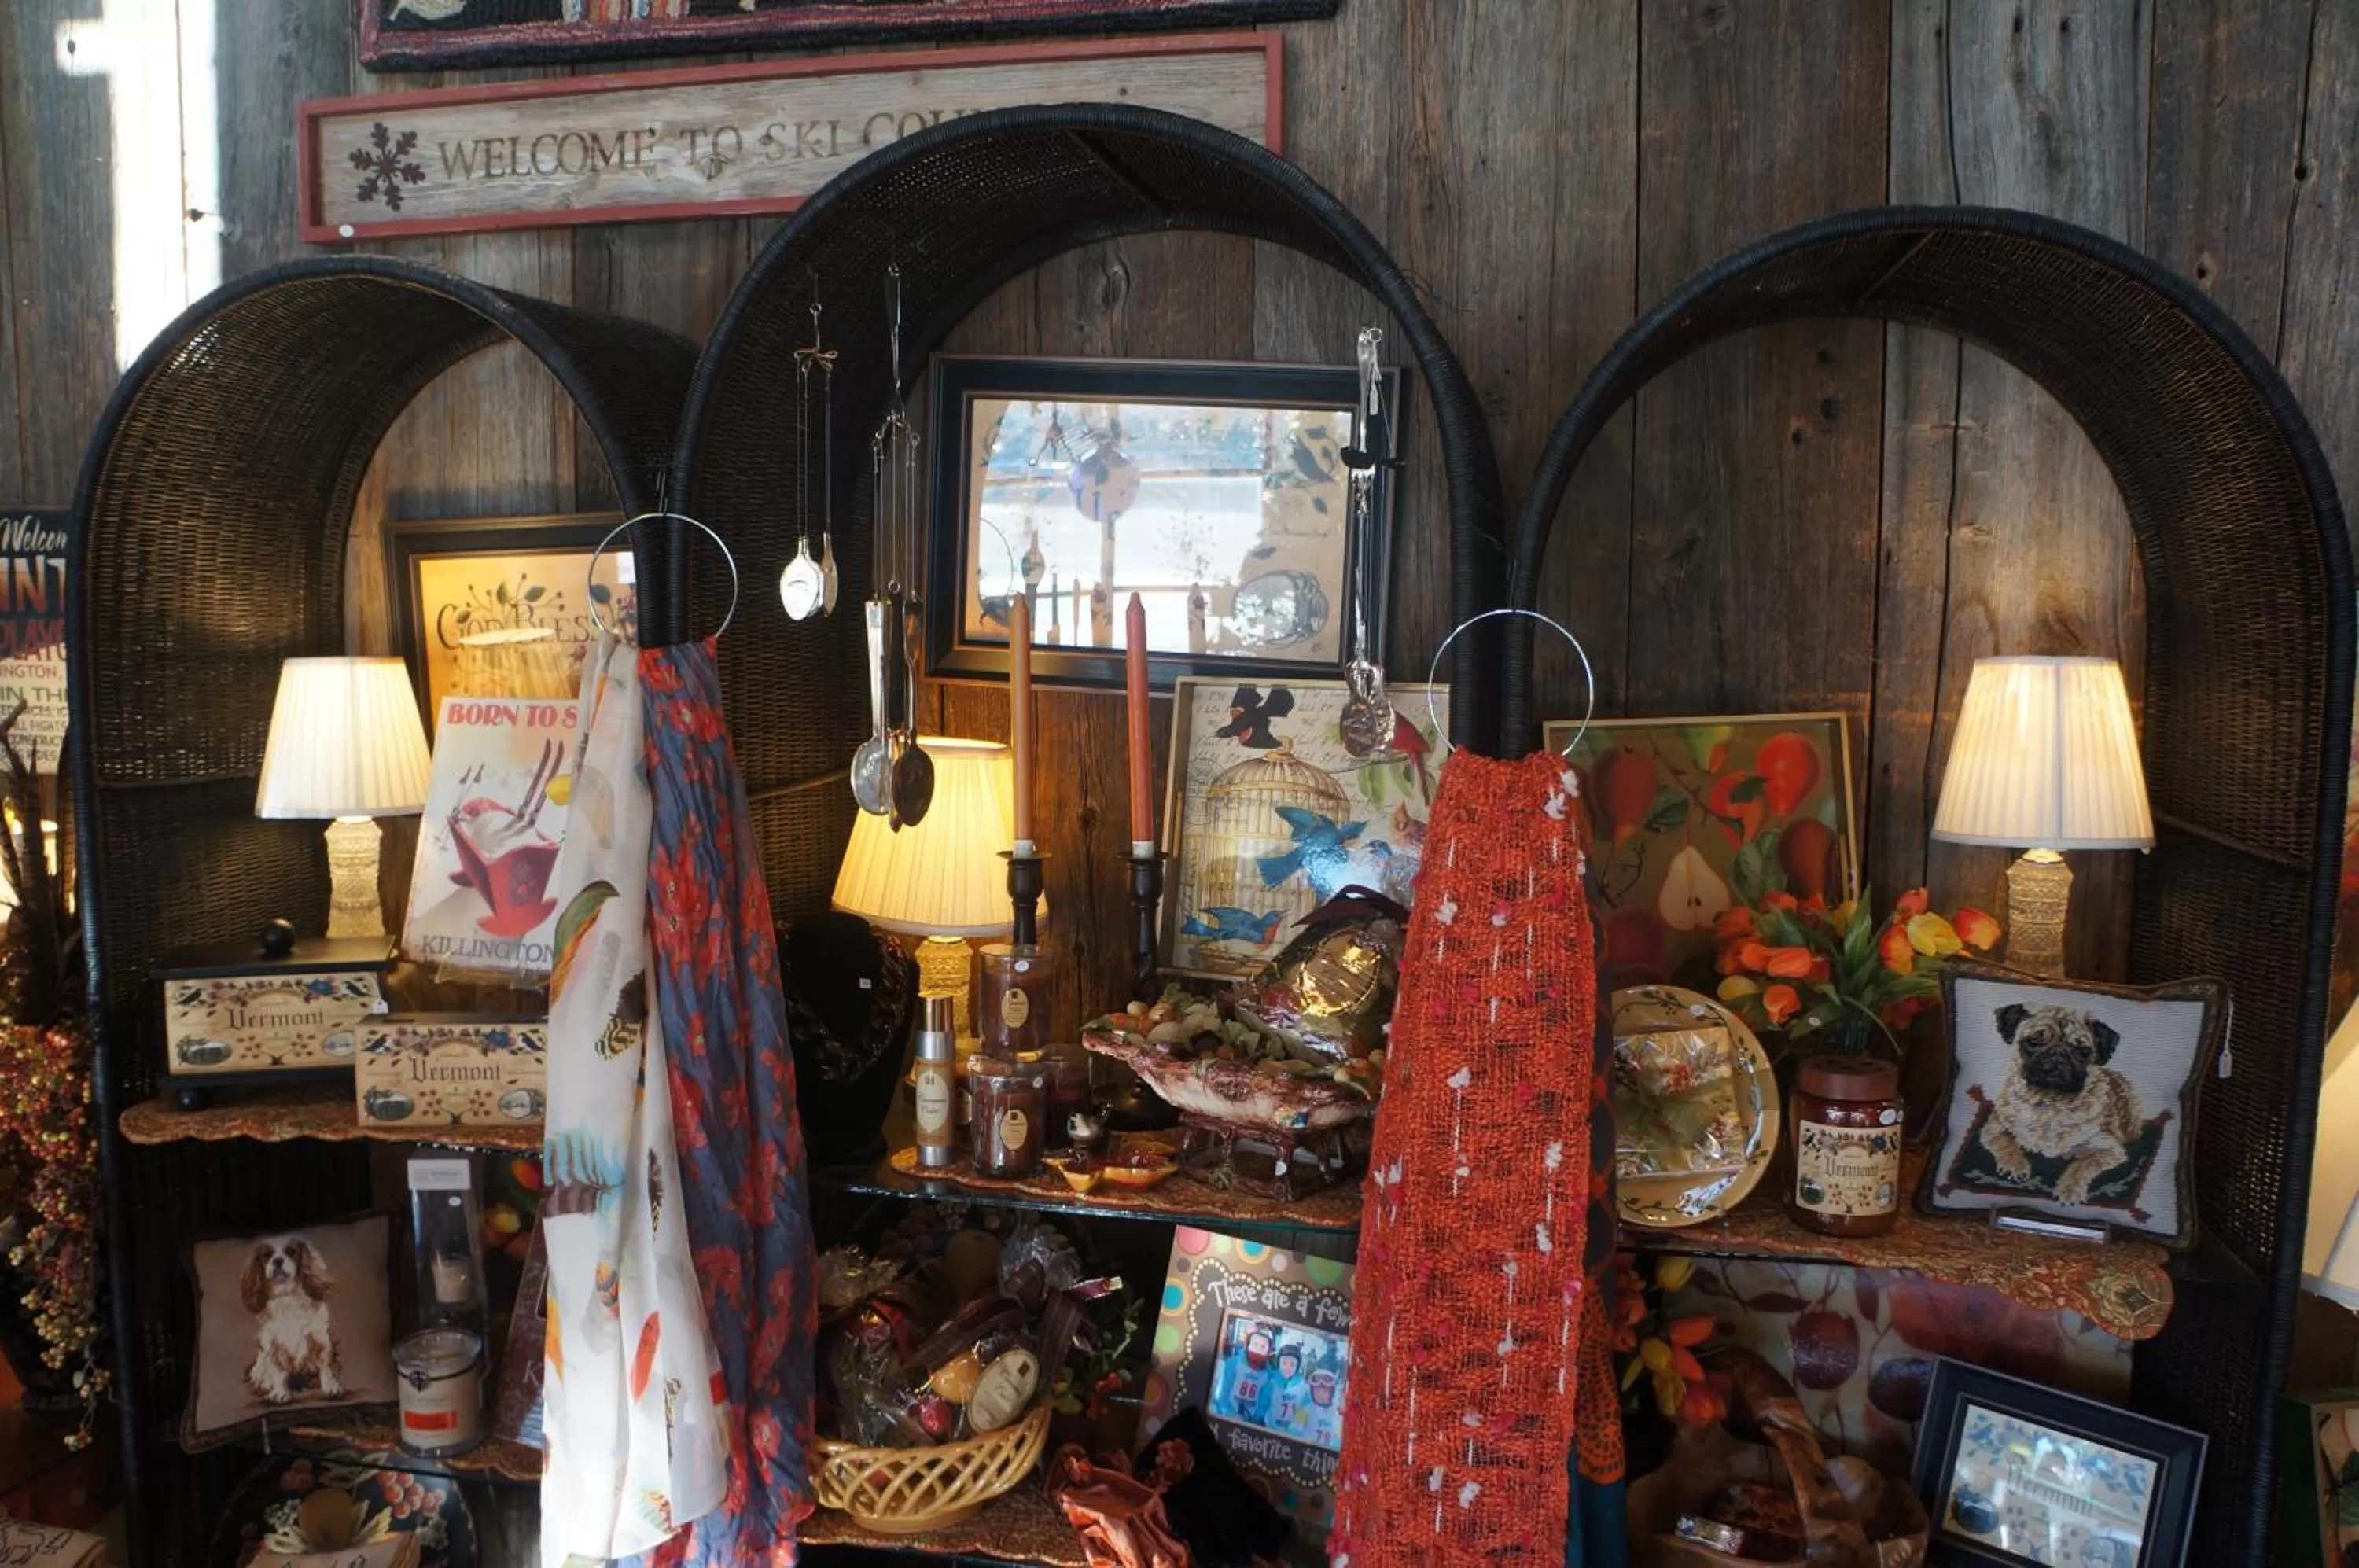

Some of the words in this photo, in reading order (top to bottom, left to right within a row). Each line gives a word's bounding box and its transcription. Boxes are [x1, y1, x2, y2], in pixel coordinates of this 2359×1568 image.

[438, 127, 654, 181] WELCOME
[679, 125, 742, 165] TO
[764, 120, 841, 160] SKI
[447, 702, 520, 727] BORN
[525, 704, 558, 727] TO
[421, 934, 554, 964] KILLINGTON
[224, 1005, 325, 1031] Vermont
[408, 1054, 501, 1083] Vermont
[1208, 1278, 1257, 1307] These
[1261, 1287, 1290, 1309] are
[1227, 1428, 1293, 1461] favorite
